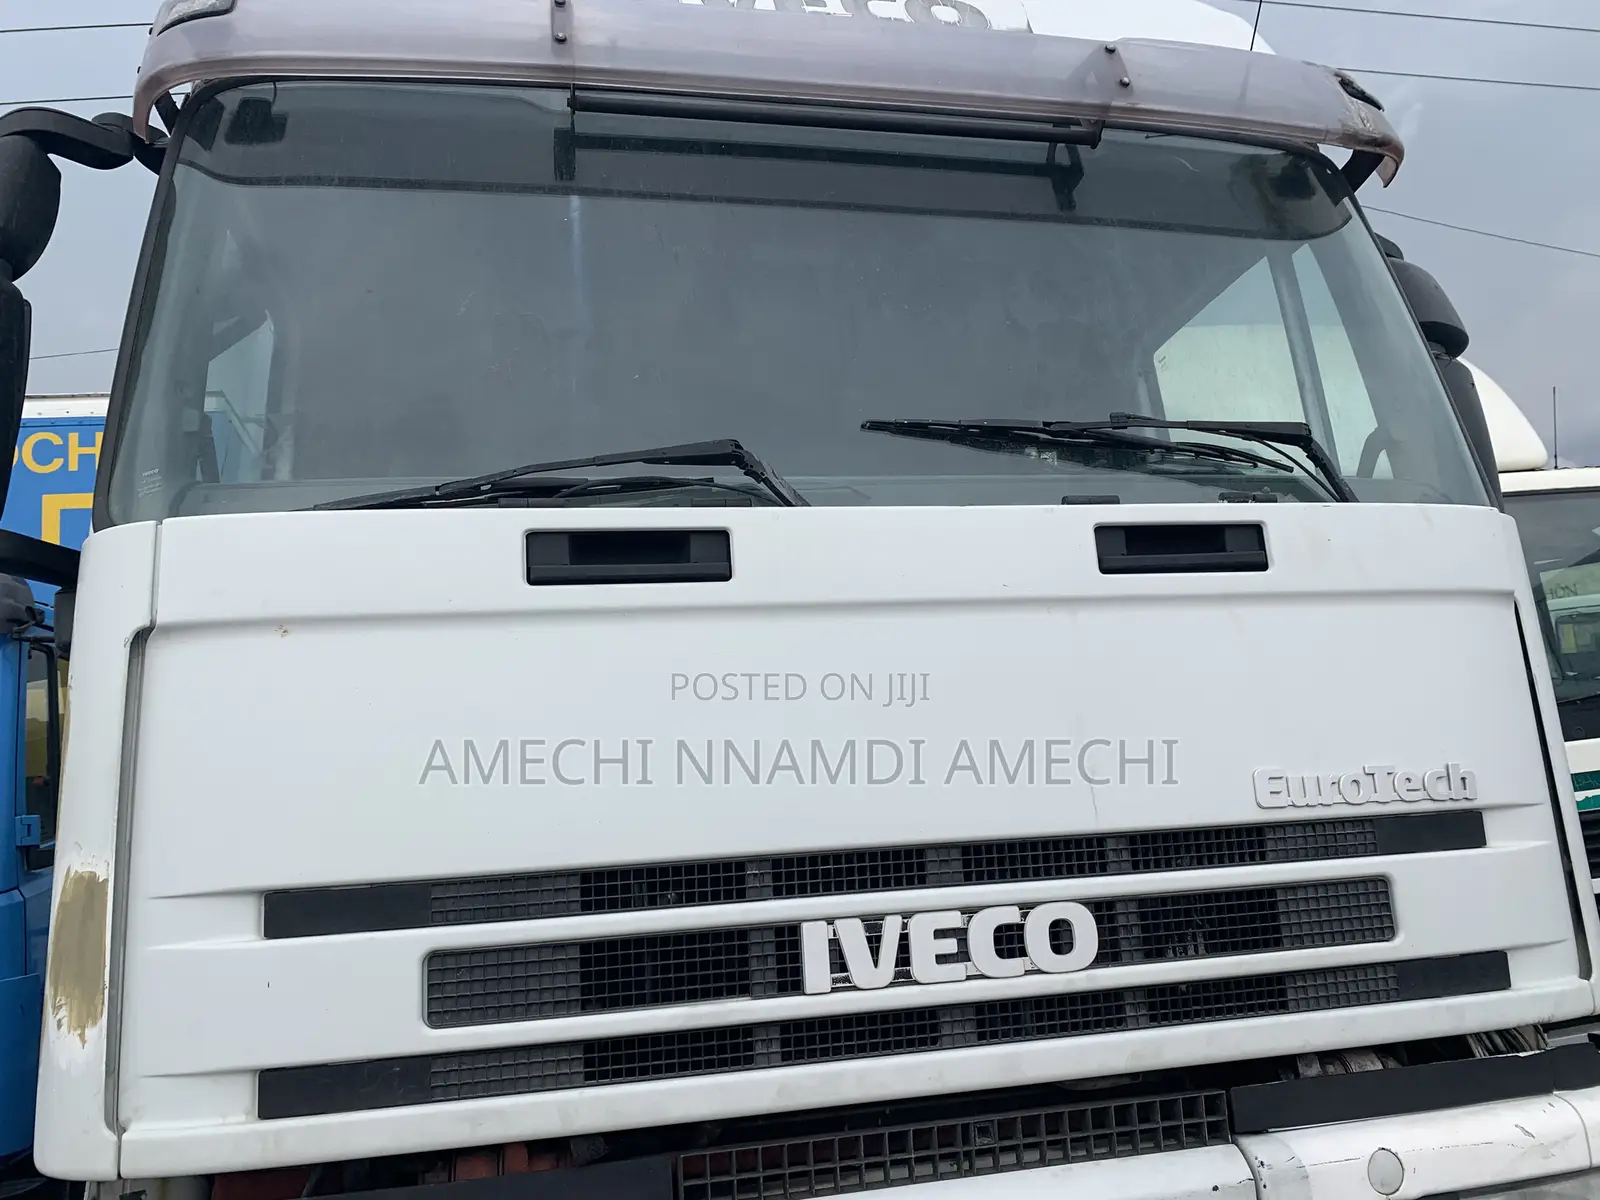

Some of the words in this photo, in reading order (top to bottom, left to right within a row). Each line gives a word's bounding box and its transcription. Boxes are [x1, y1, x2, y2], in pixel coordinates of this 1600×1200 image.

[13, 431, 104, 474] CH
[1253, 762, 1478, 809] EuroTech
[801, 901, 1099, 995] IVECO
